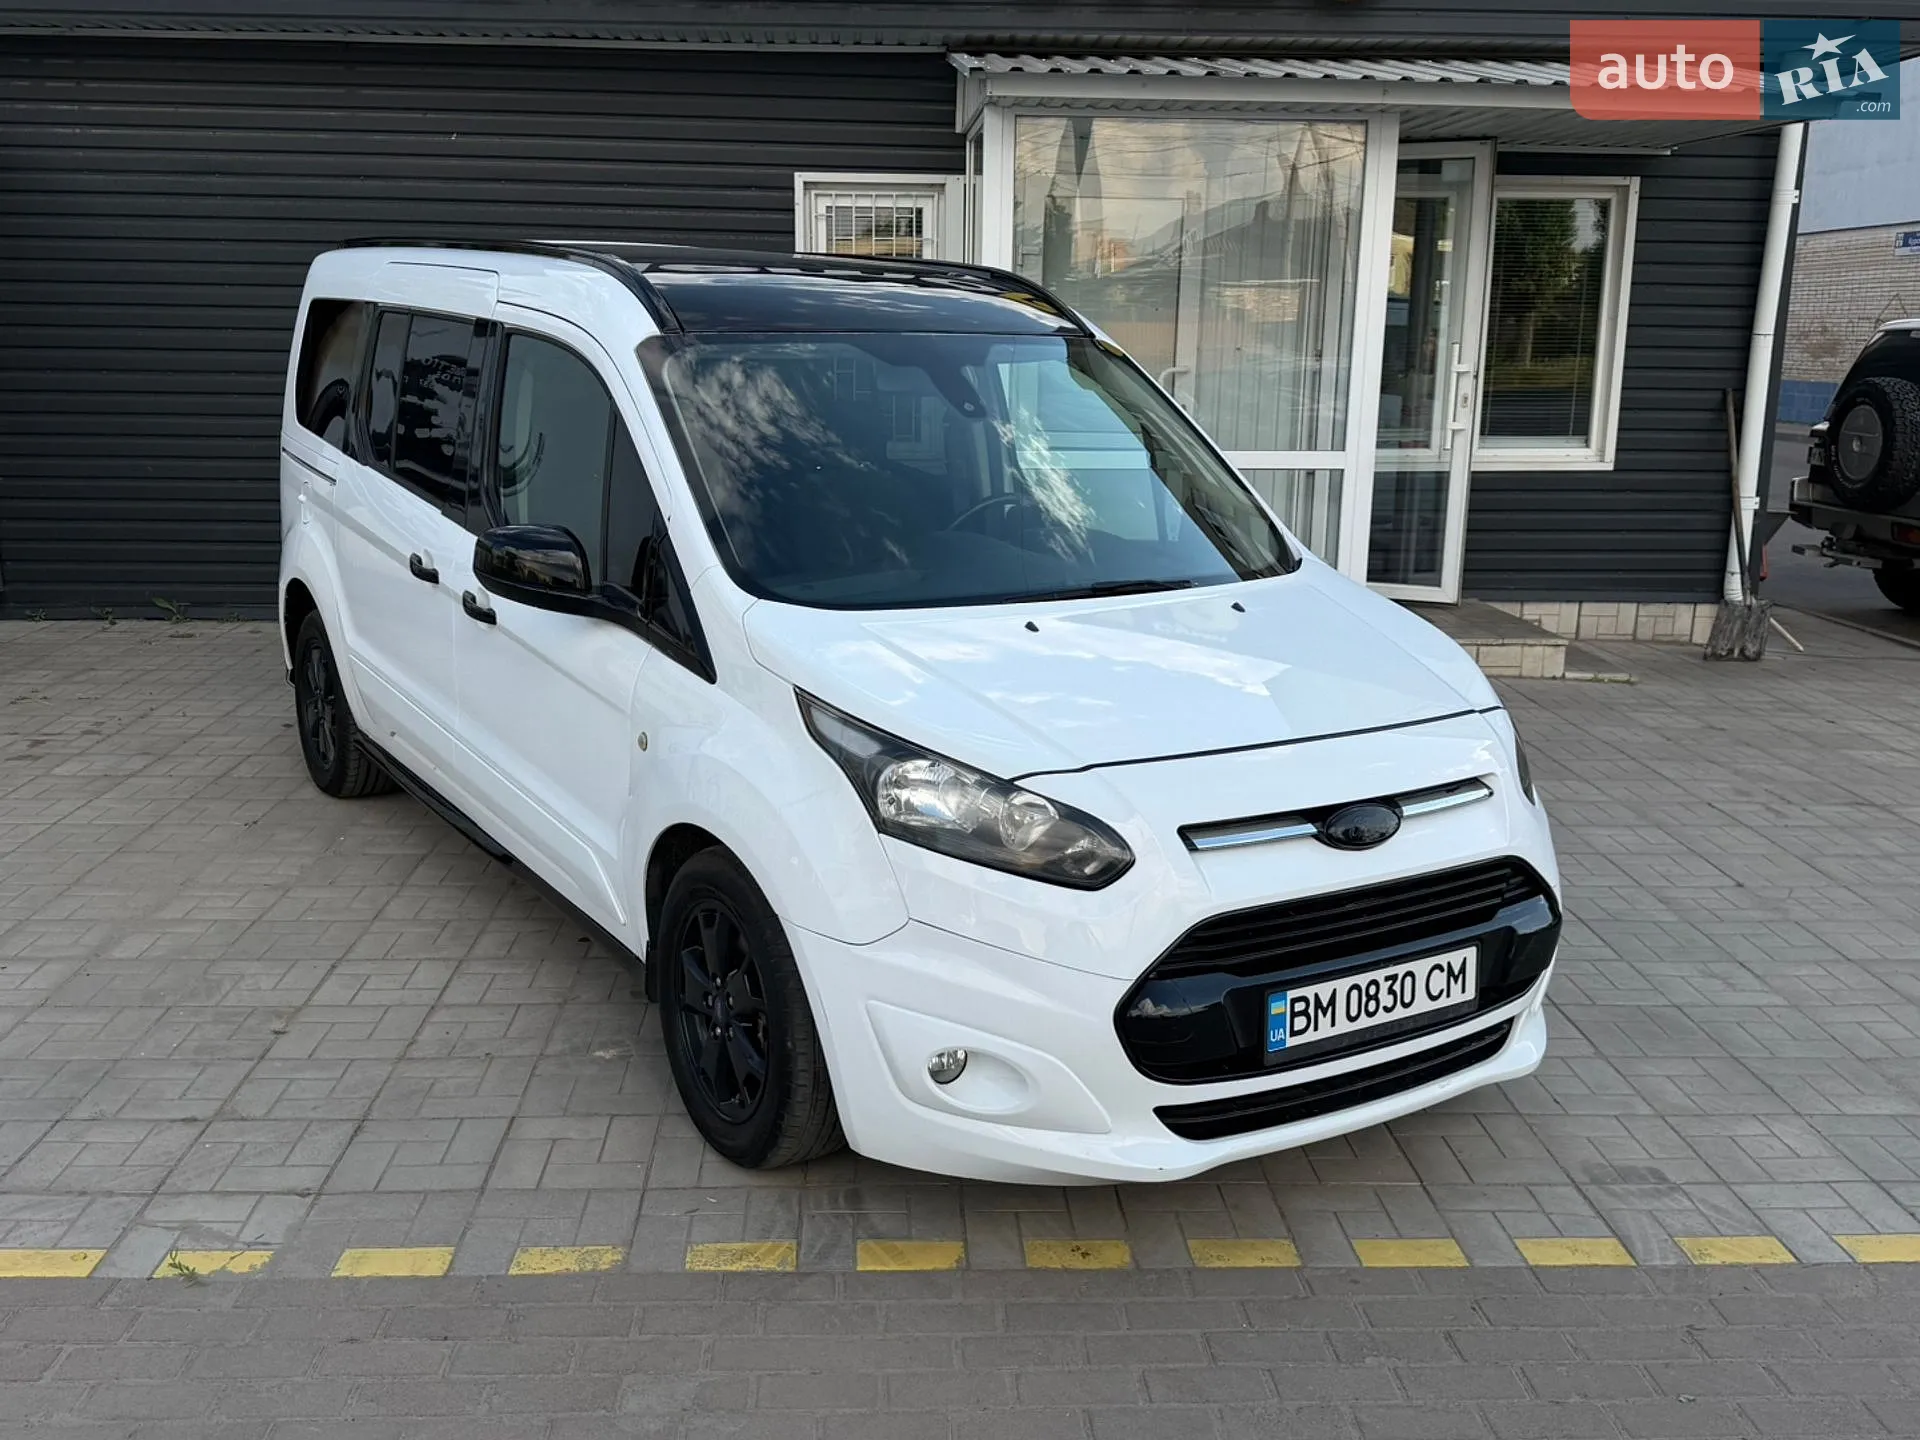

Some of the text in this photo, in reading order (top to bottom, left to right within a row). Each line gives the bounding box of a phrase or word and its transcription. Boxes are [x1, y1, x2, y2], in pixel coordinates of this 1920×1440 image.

[1289, 957, 1467, 1038] BM 0830 CM
[1270, 1027, 1285, 1042] UA
